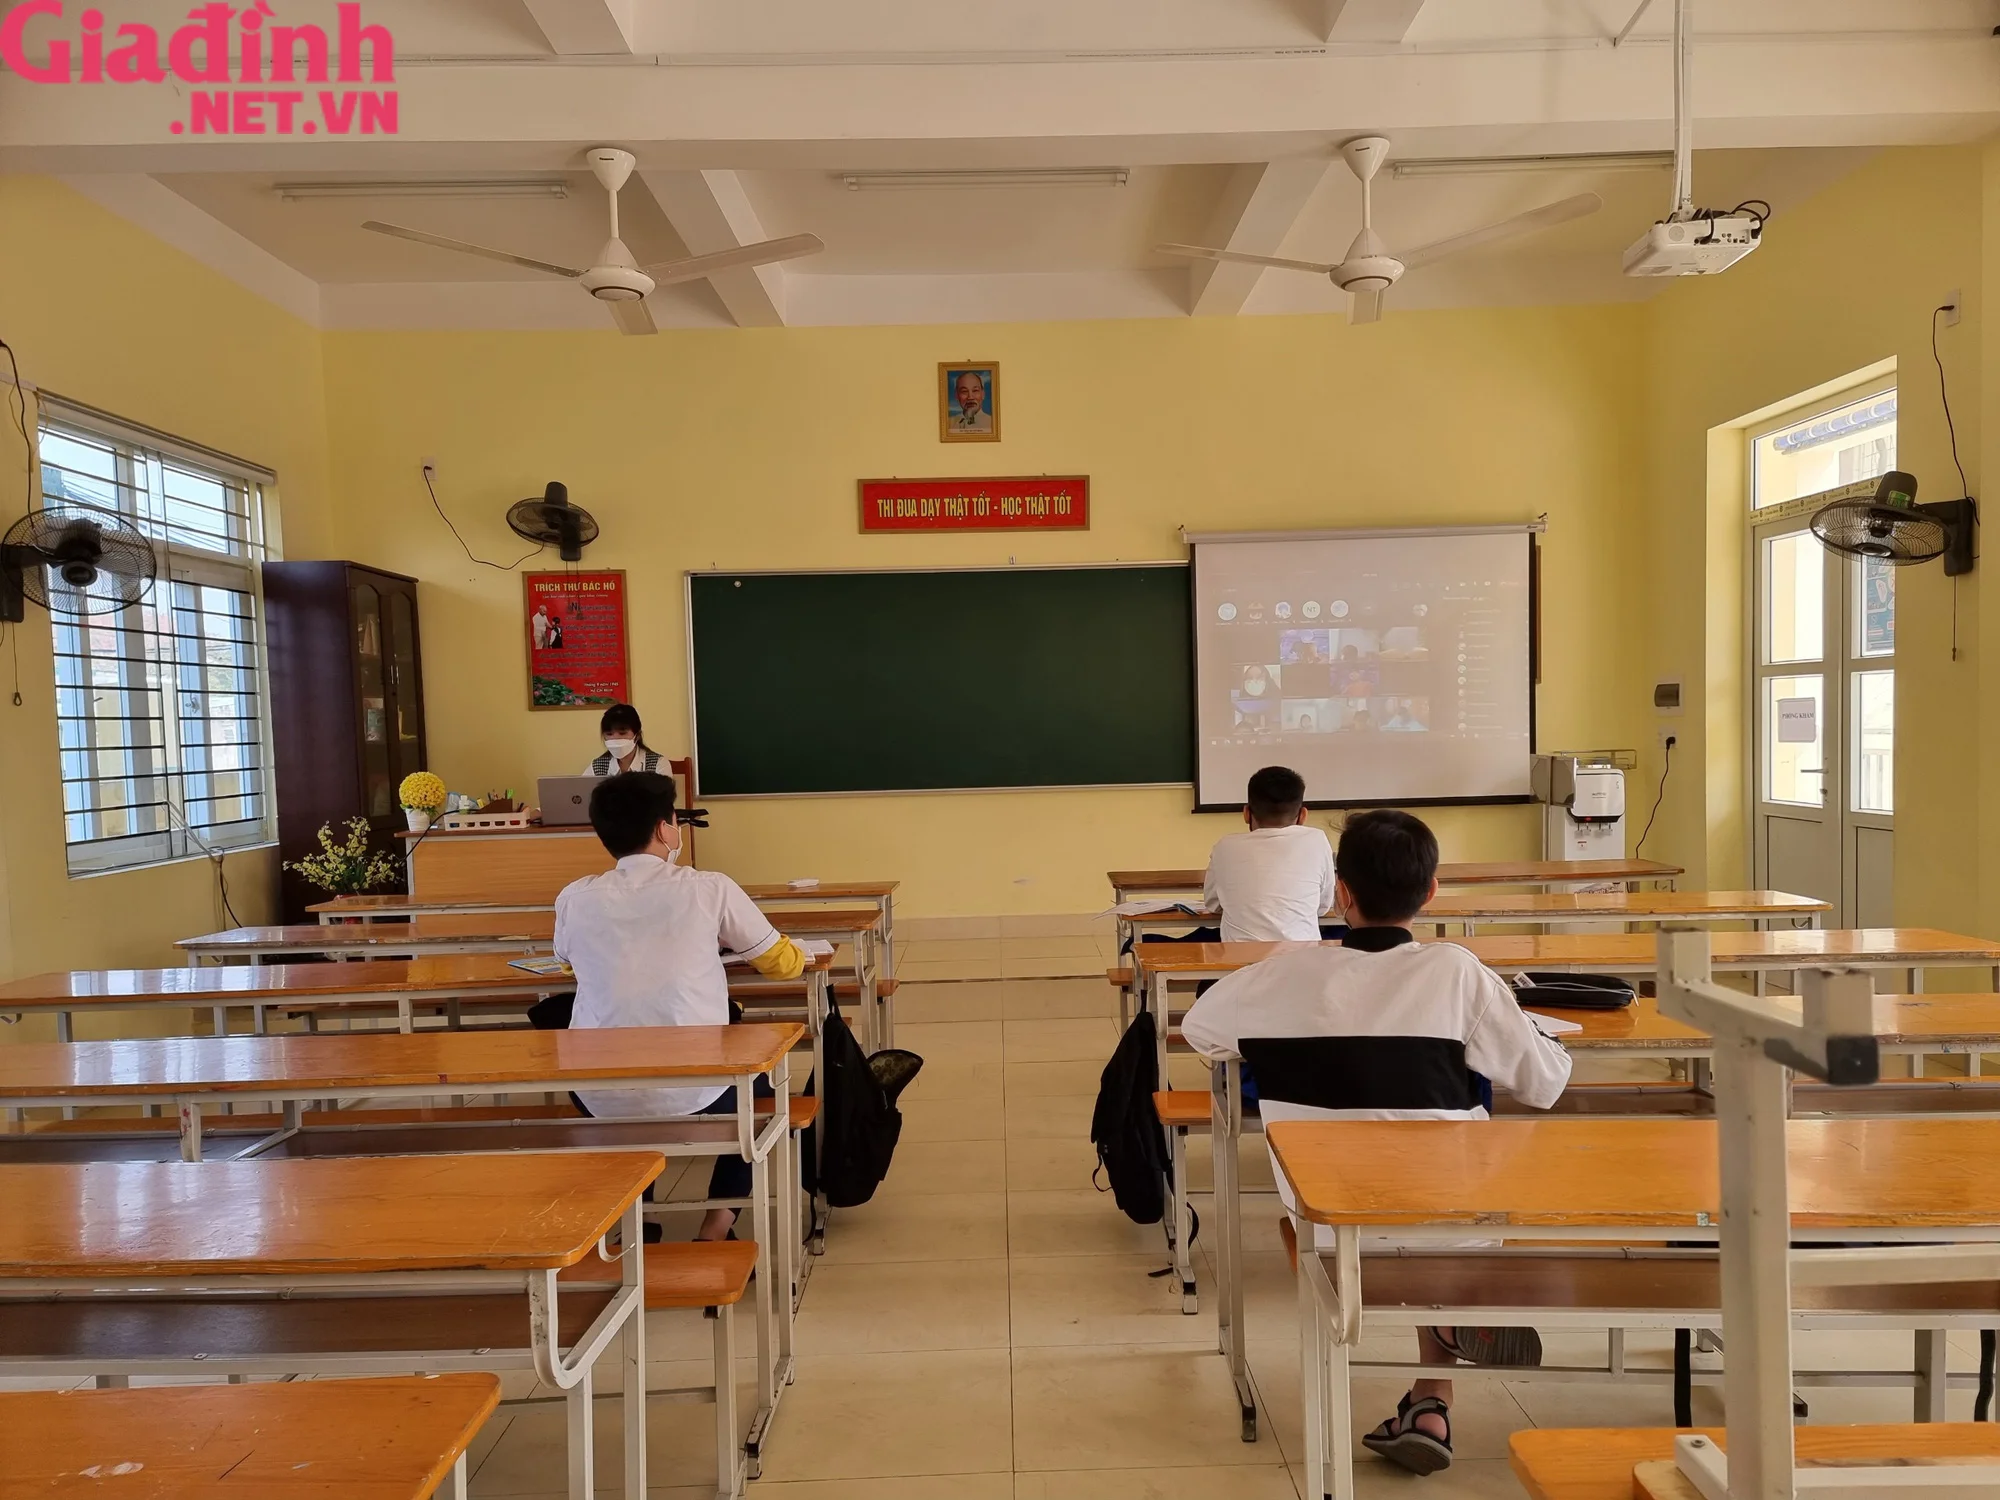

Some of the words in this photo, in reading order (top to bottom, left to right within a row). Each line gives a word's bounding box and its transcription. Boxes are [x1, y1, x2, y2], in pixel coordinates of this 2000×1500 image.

[877, 498, 895, 518] THI
[896, 498, 918, 518] ĐUA
[920, 498, 941, 521] DẠY
[943, 493, 970, 521] THẬT
[972, 490, 991, 517] TỐT
[1001, 496, 1022, 520] HỌC
[1024, 492, 1051, 520] THẬT
[1053, 489, 1072, 516] TỐT
[534, 582, 561, 592] TRÍCH
[563, 581, 581, 592] THƯ
[582, 581, 601, 591] BÁC
